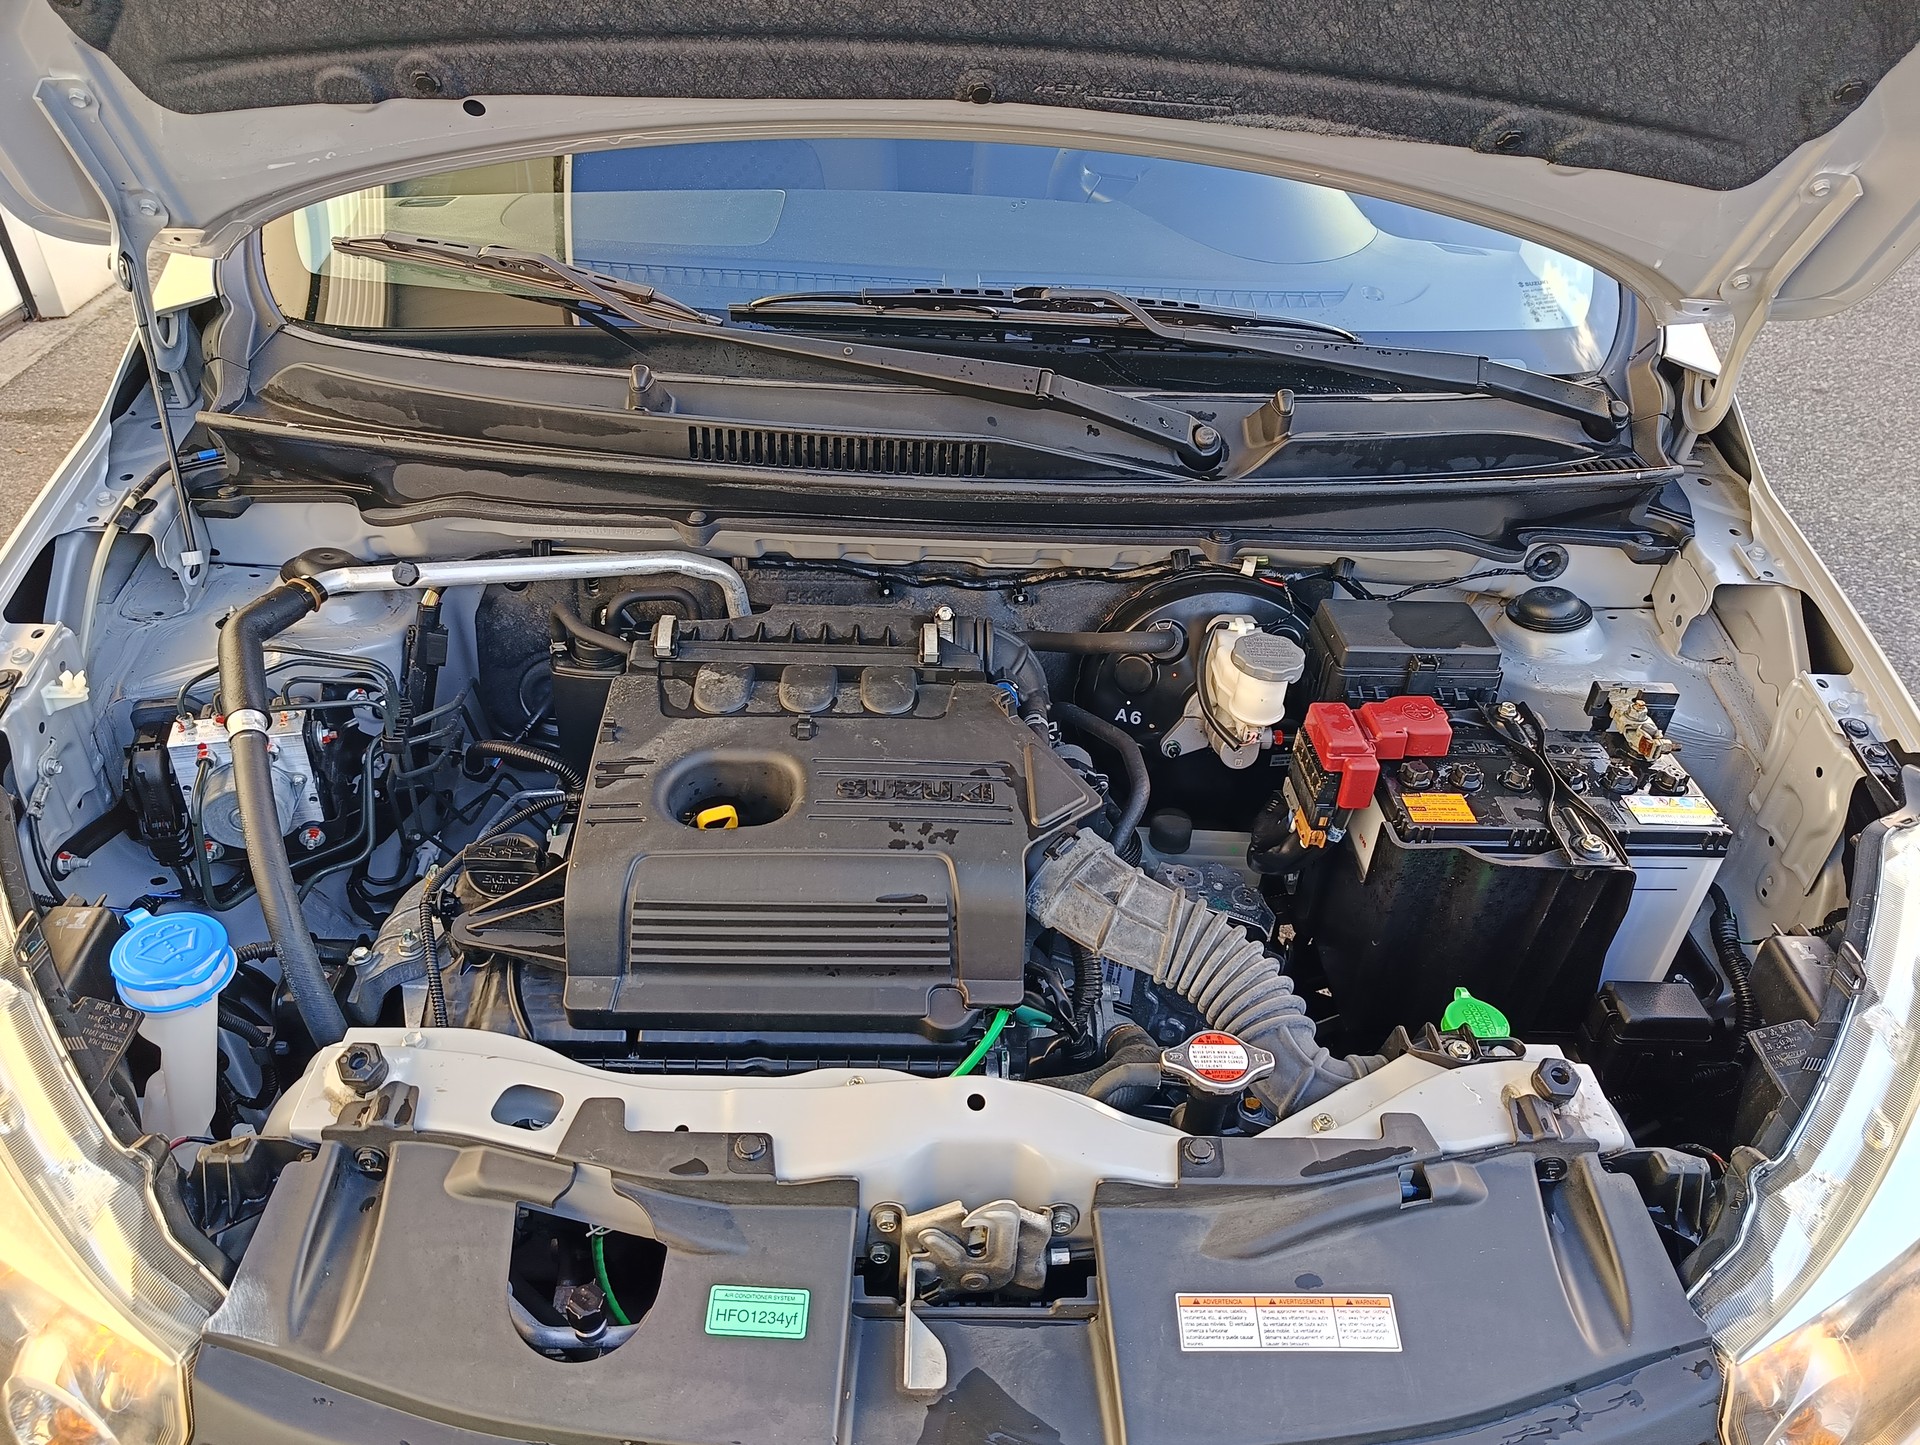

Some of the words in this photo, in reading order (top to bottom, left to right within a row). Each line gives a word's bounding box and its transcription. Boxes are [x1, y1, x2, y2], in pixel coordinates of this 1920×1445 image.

[1114, 708, 1142, 725] A6
[836, 778, 995, 804] SUZUKI
[715, 1308, 799, 1329] HFO1234yf
